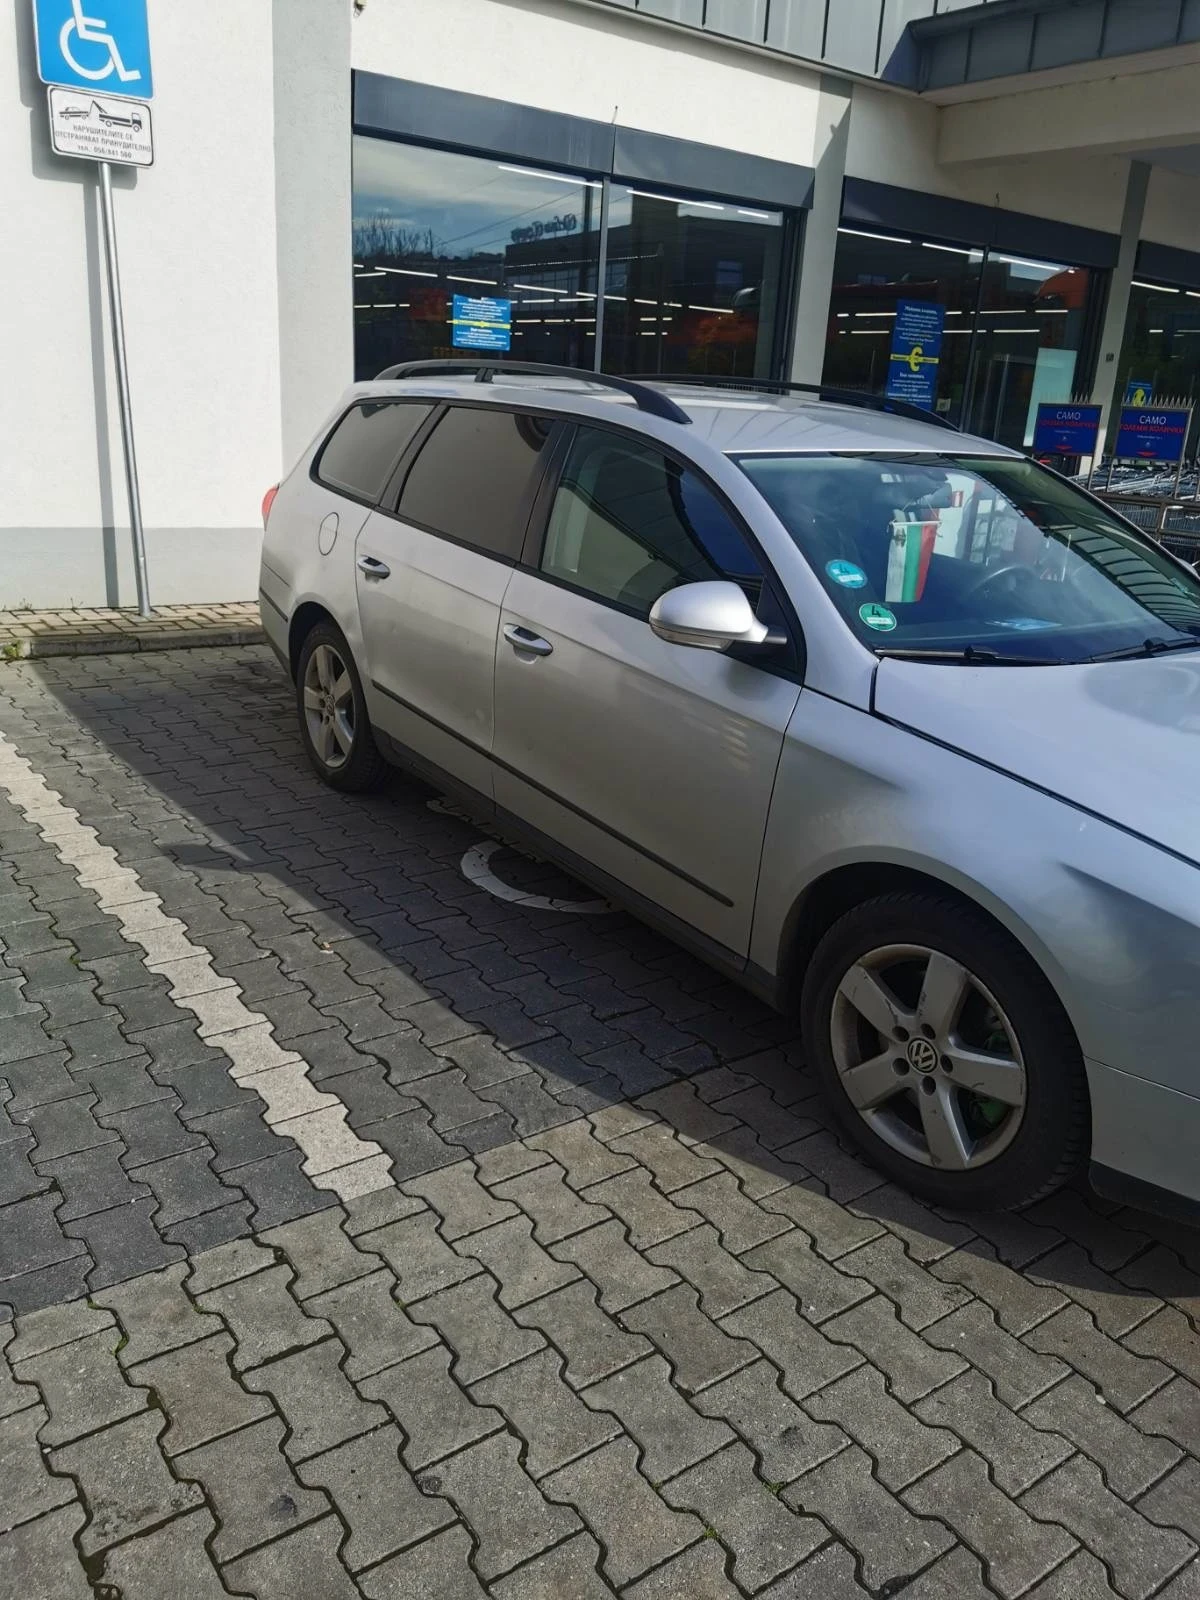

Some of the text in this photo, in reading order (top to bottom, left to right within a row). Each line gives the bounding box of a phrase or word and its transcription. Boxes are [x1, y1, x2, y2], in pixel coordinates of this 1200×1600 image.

[73, 125, 123, 140] НАРУШИТЕЛИТЕ
[1056, 411, 1081, 421] САМО
[1139, 415, 1167, 425] САМО
[871, 605, 881, 617] 4
